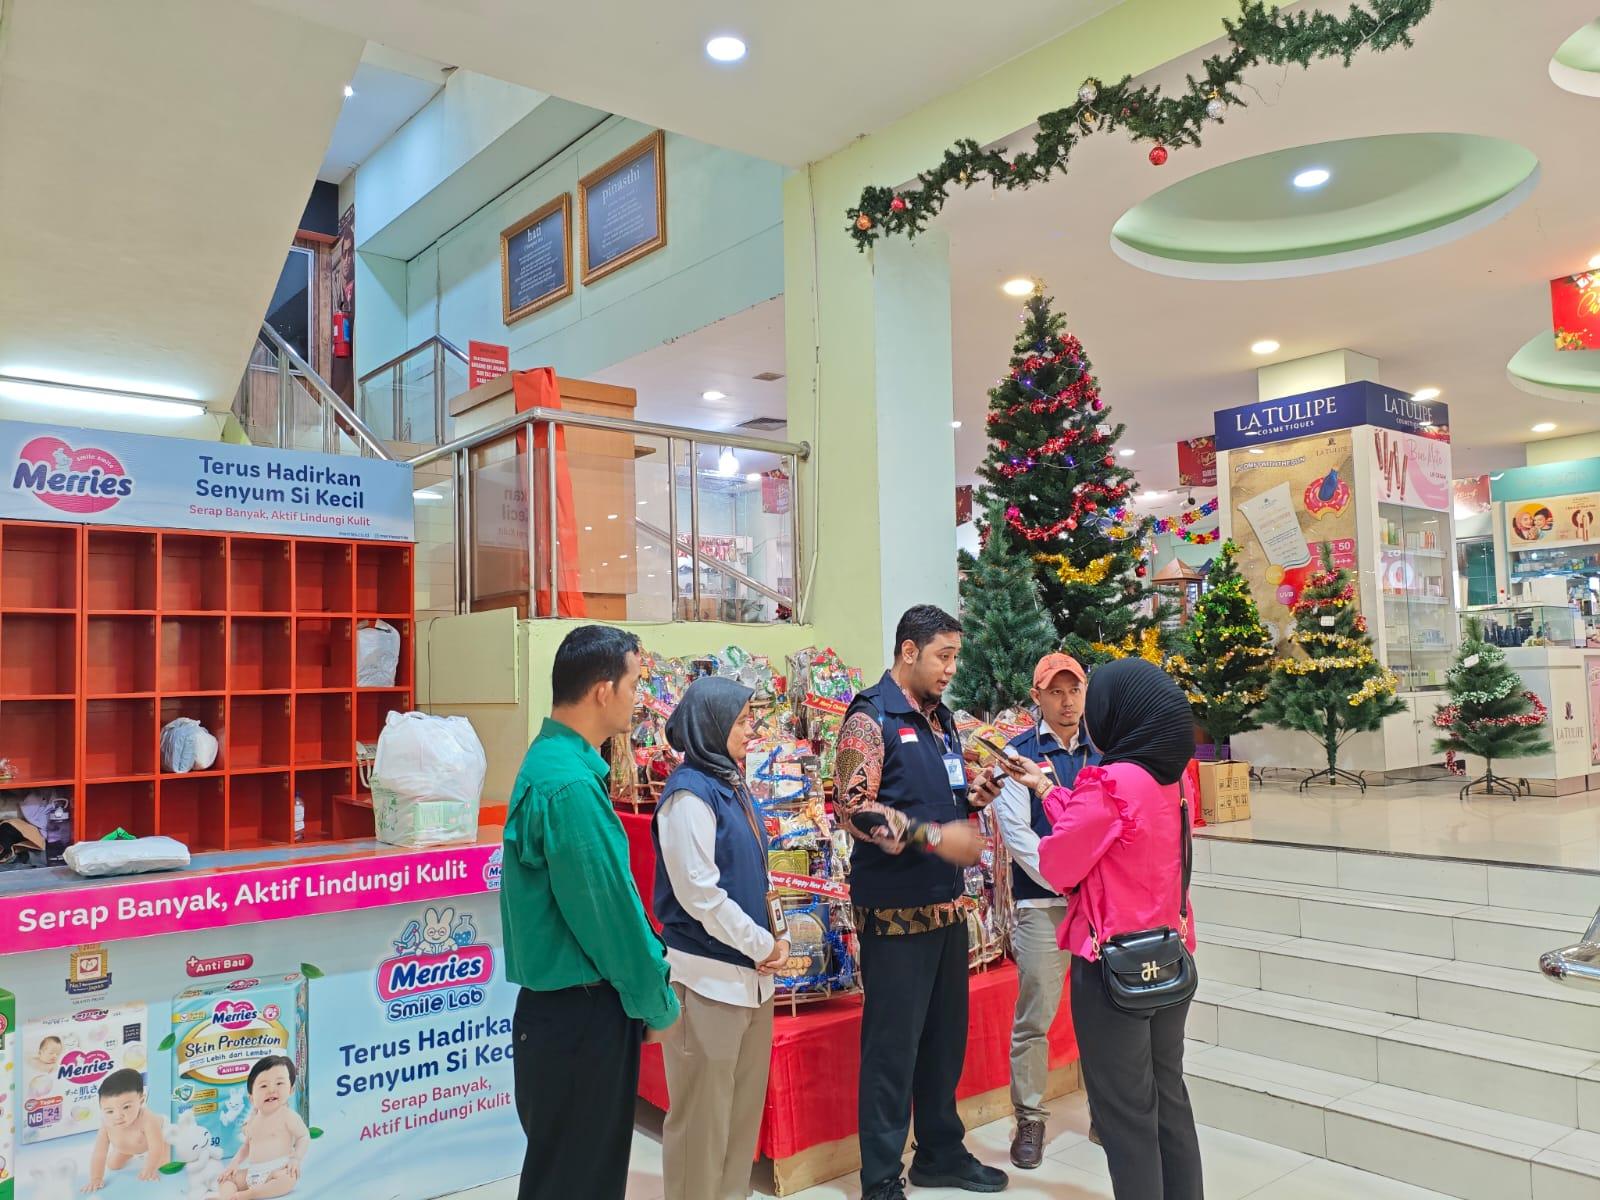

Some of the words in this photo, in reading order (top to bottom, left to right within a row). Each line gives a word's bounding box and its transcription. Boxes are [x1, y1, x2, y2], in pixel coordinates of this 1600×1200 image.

[1257, 419, 1315, 436] COSMETIQUES
[12, 463, 133, 497] Merries
[199, 455, 260, 479] Terus
[266, 462, 361, 488] Hadirkan
[195, 478, 285, 506] Senyum
[290, 485, 310, 505] Si
[316, 489, 364, 509] Kecil
[189, 504, 223, 519] Serap
[225, 507, 269, 521] Banyak,
[271, 509, 298, 522] Aktif
[299, 512, 345, 527] Lindungi
[346, 515, 371, 527] Kulit
[1338, 541, 1351, 551] 50
[18, 901, 109, 933] Serap
[117, 889, 229, 921] Banyak,
[234, 877, 300, 906] Aktif
[305, 866, 411, 898] Lindungi
[416, 861, 468, 884] Kulit
[196, 961, 221, 974] Anti
[224, 957, 246, 970] Bau
[391, 956, 482, 991] Merries
[212, 1009, 258, 1024] Merries
[389, 997, 443, 1019] Smile
[447, 987, 483, 1009] Lab
[185, 1043, 215, 1058] Skin
[218, 1035, 281, 1050] Protection
[206, 1054, 226, 1063] Lebih
[228, 1051, 242, 1059] dari
[246, 1048, 272, 1057] Lembut
[339, 1039, 411, 1067] Terus
[418, 1015, 512, 1051] Hadirka
[57, 1060, 115, 1080] Merries
[336, 1060, 439, 1097] Senyum
[446, 1048, 467, 1073] Si
[475, 1043, 514, 1067] Kec
[381, 1093, 428, 1113] Serap
[432, 1076, 492, 1102] Banyak,
[29, 1112, 43, 1125] NB
[48, 1107, 60, 1117] 24
[359, 1117, 401, 1142] Aktif
[404, 1102, 473, 1130] Lindungi
[477, 1092, 511, 1112] Kulit
